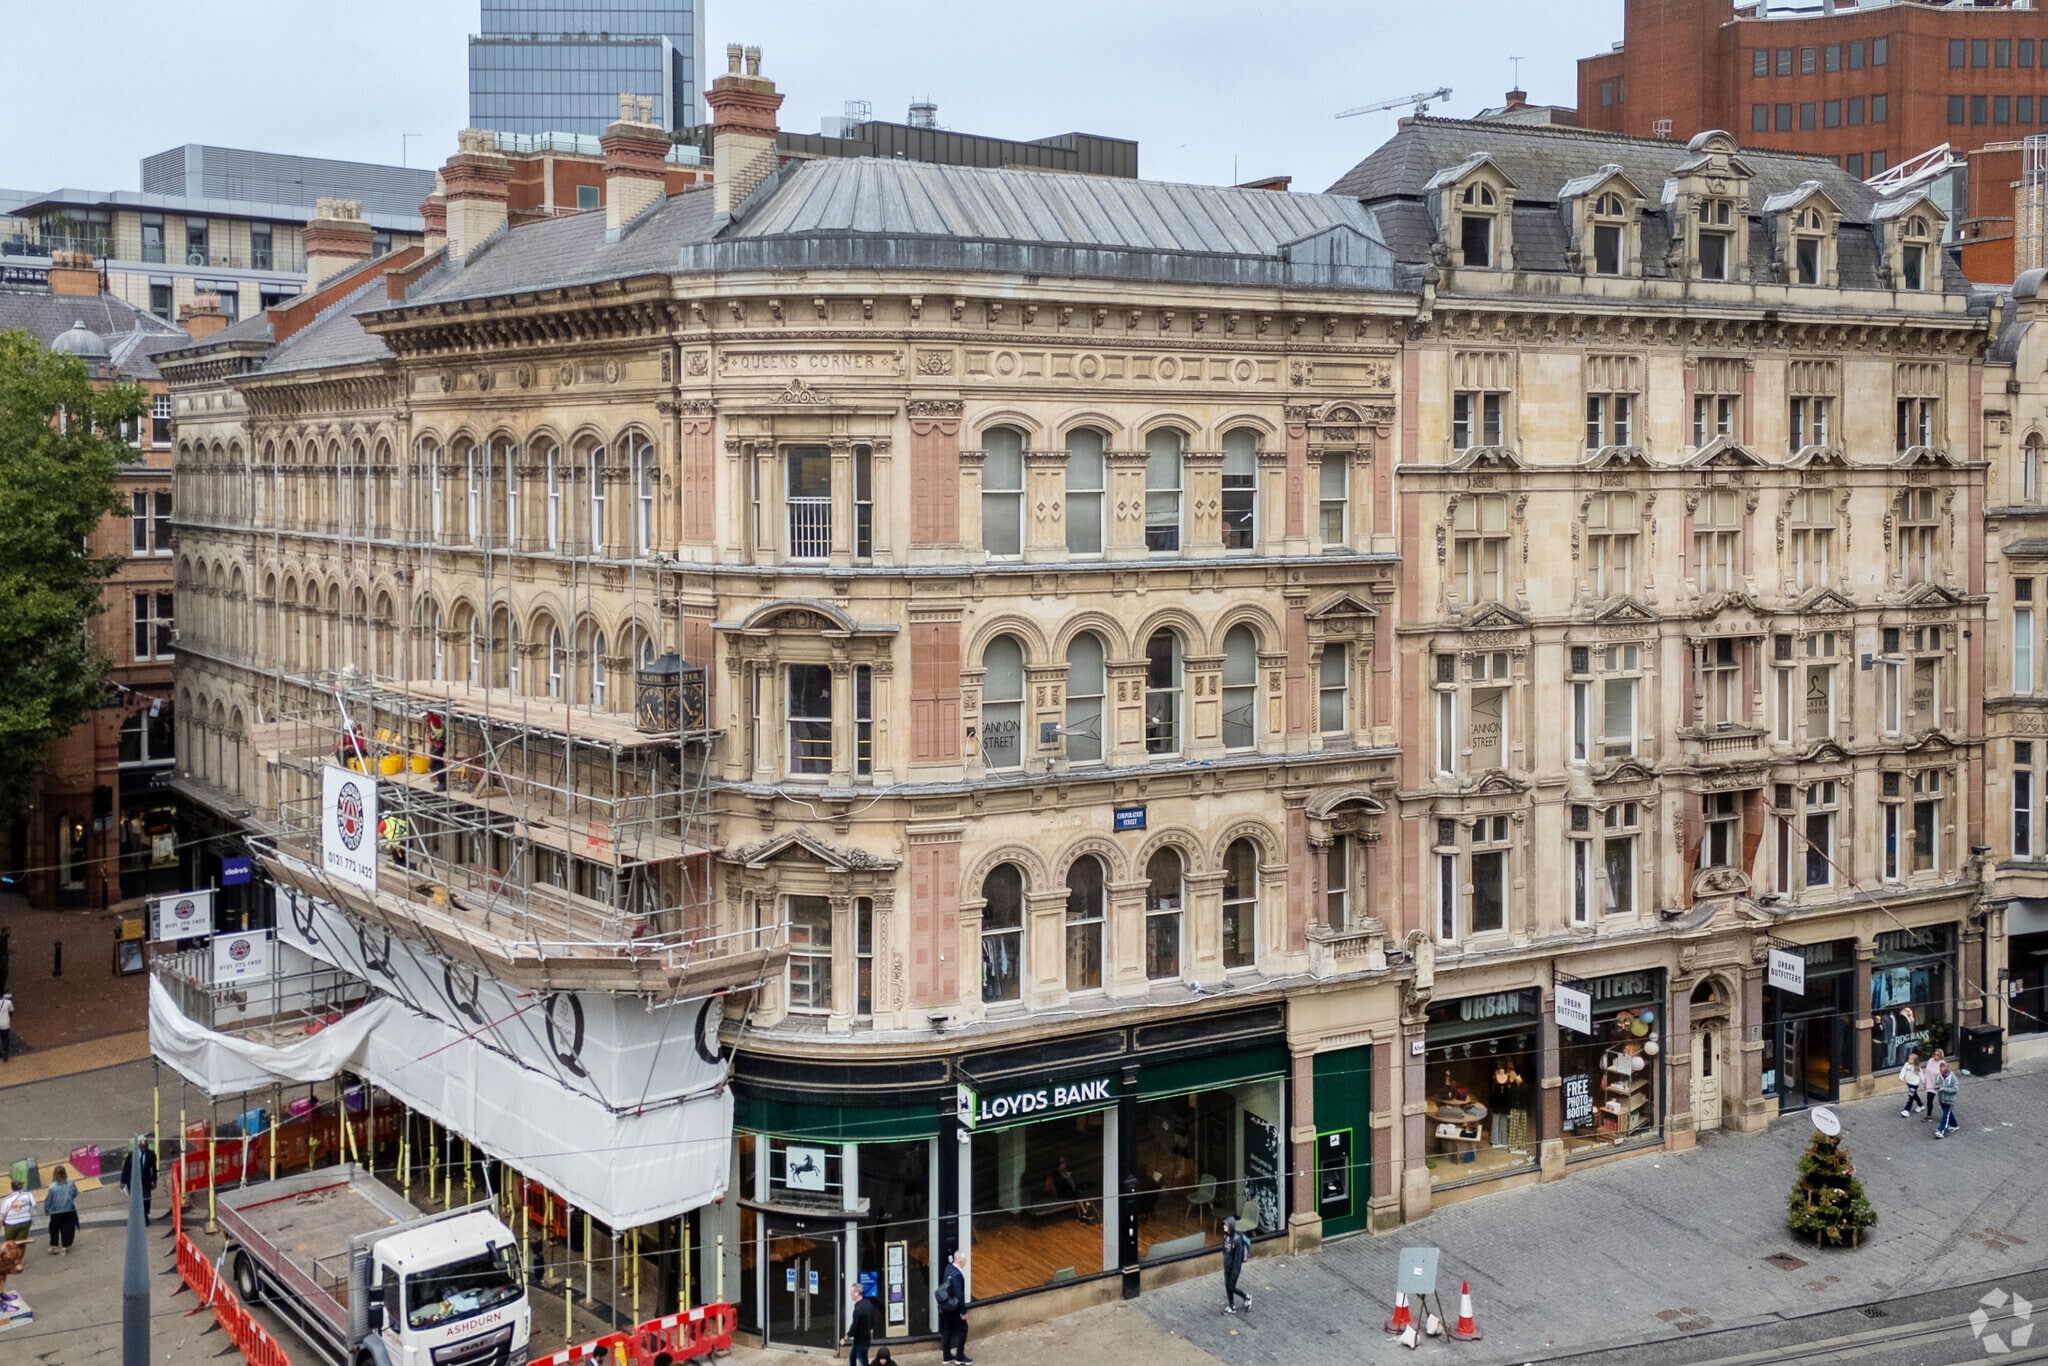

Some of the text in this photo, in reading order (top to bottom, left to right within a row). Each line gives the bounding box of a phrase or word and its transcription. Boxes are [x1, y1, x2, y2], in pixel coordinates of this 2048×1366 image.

[741, 355, 874, 369] QUEENS CORNER
[984, 735, 1016, 749] STREET
[1473, 736, 1498, 748] STREET
[328, 851, 373, 879] 0121 772 1422
[1806, 945, 1833, 965] BAN
[1778, 960, 1795, 972] URBAN
[1771, 967, 1802, 984] OUTFITTERS
[1460, 992, 1520, 1021] URBAN
[1563, 996, 1582, 1008] URBAN
[1557, 1005, 1588, 1023] OUTFITTERS
[1567, 1079, 1588, 1097] FREE
[975, 1079, 1110, 1121] LOYDS BANK
[1567, 1094, 1588, 1109] PHOTO
[1567, 1105, 1589, 1119] BOOTH
[447, 1313, 502, 1336] ASHDURN
